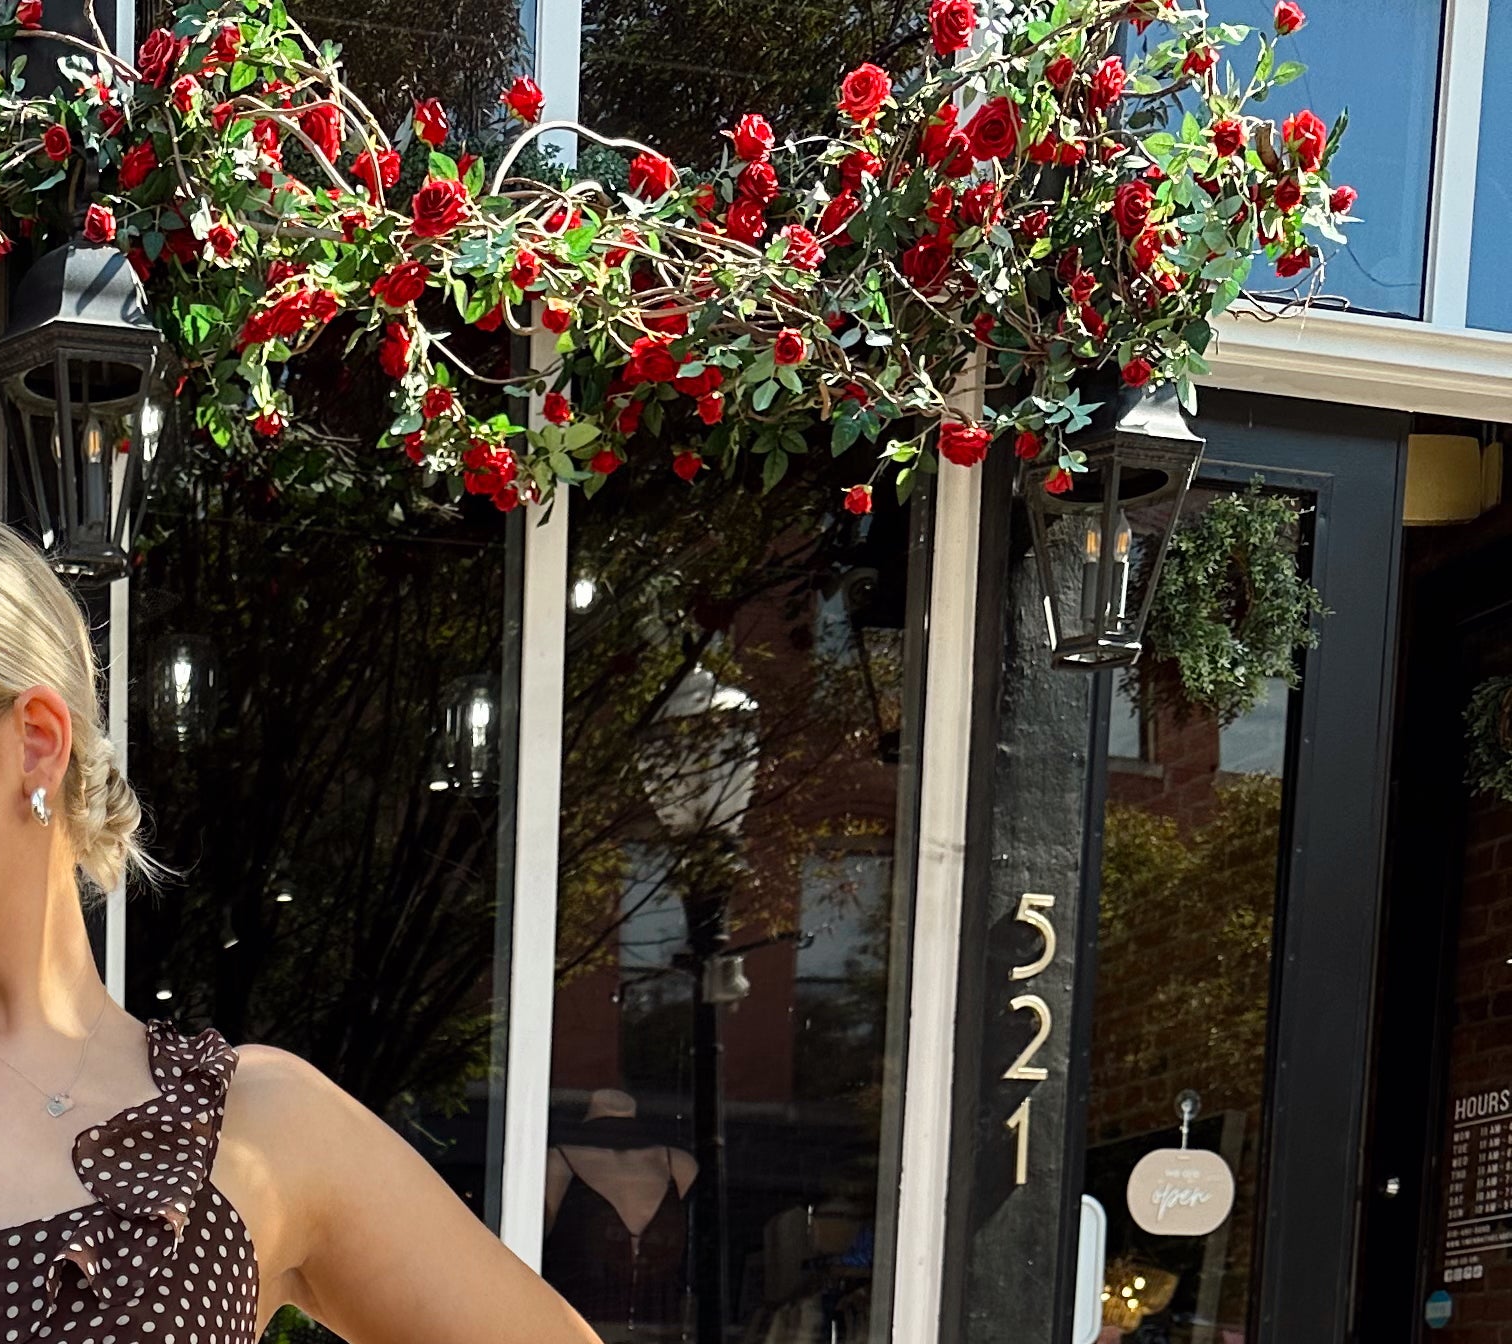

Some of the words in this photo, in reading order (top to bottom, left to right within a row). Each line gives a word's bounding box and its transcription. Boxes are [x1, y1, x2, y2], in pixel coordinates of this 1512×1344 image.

[1001, 893, 1056, 1185] 521
[1454, 1089, 1510, 1121] HOURS
[1152, 1183, 1212, 1221] open
